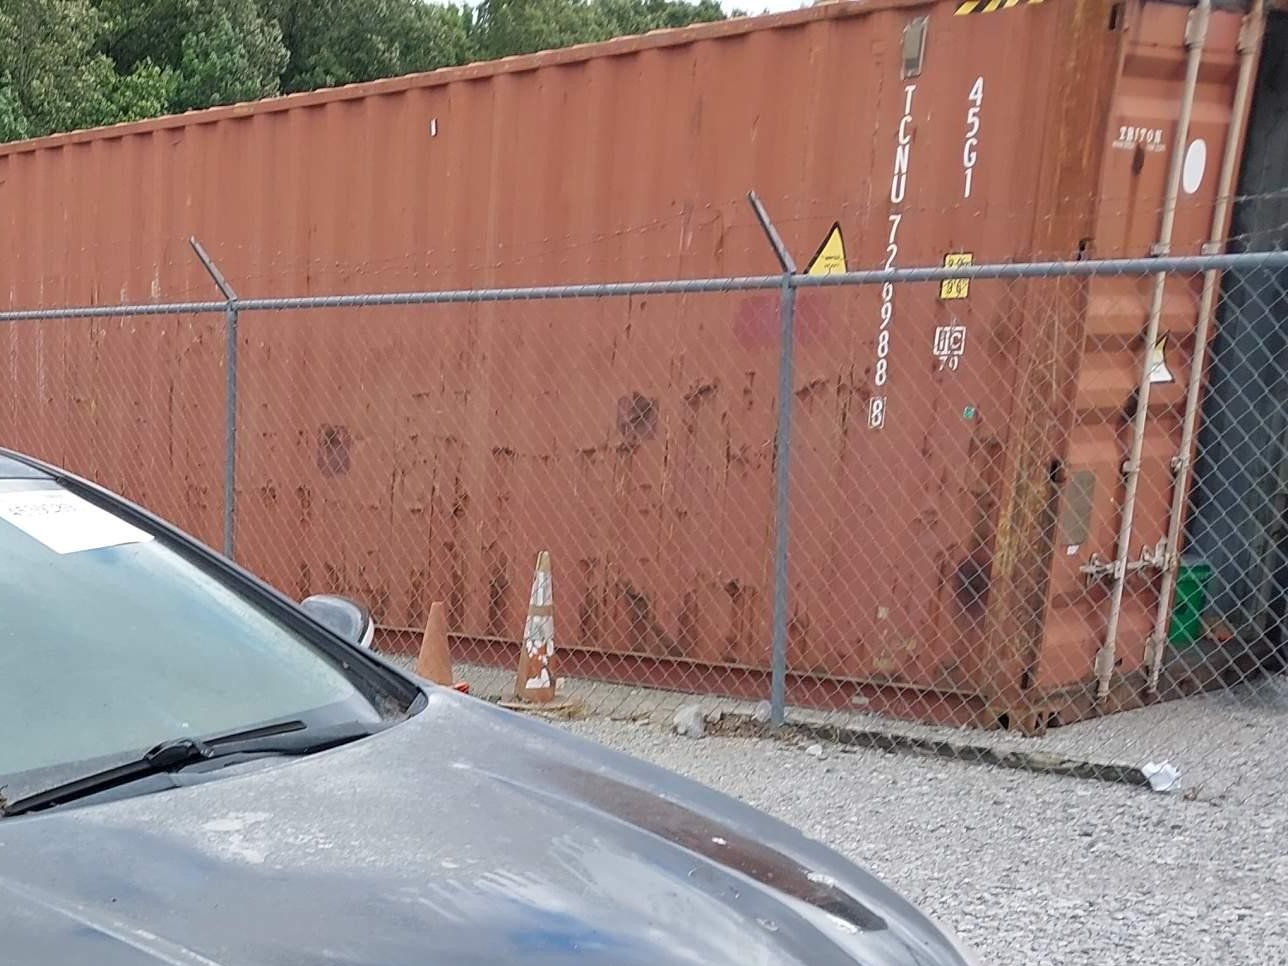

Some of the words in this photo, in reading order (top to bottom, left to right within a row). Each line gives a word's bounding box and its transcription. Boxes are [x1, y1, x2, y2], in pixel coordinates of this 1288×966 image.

[890, 84, 917, 204] TCNU
[963, 76, 984, 198] 45G1
[875, 213, 902, 386] 726988
[871, 399, 883, 427] 8
